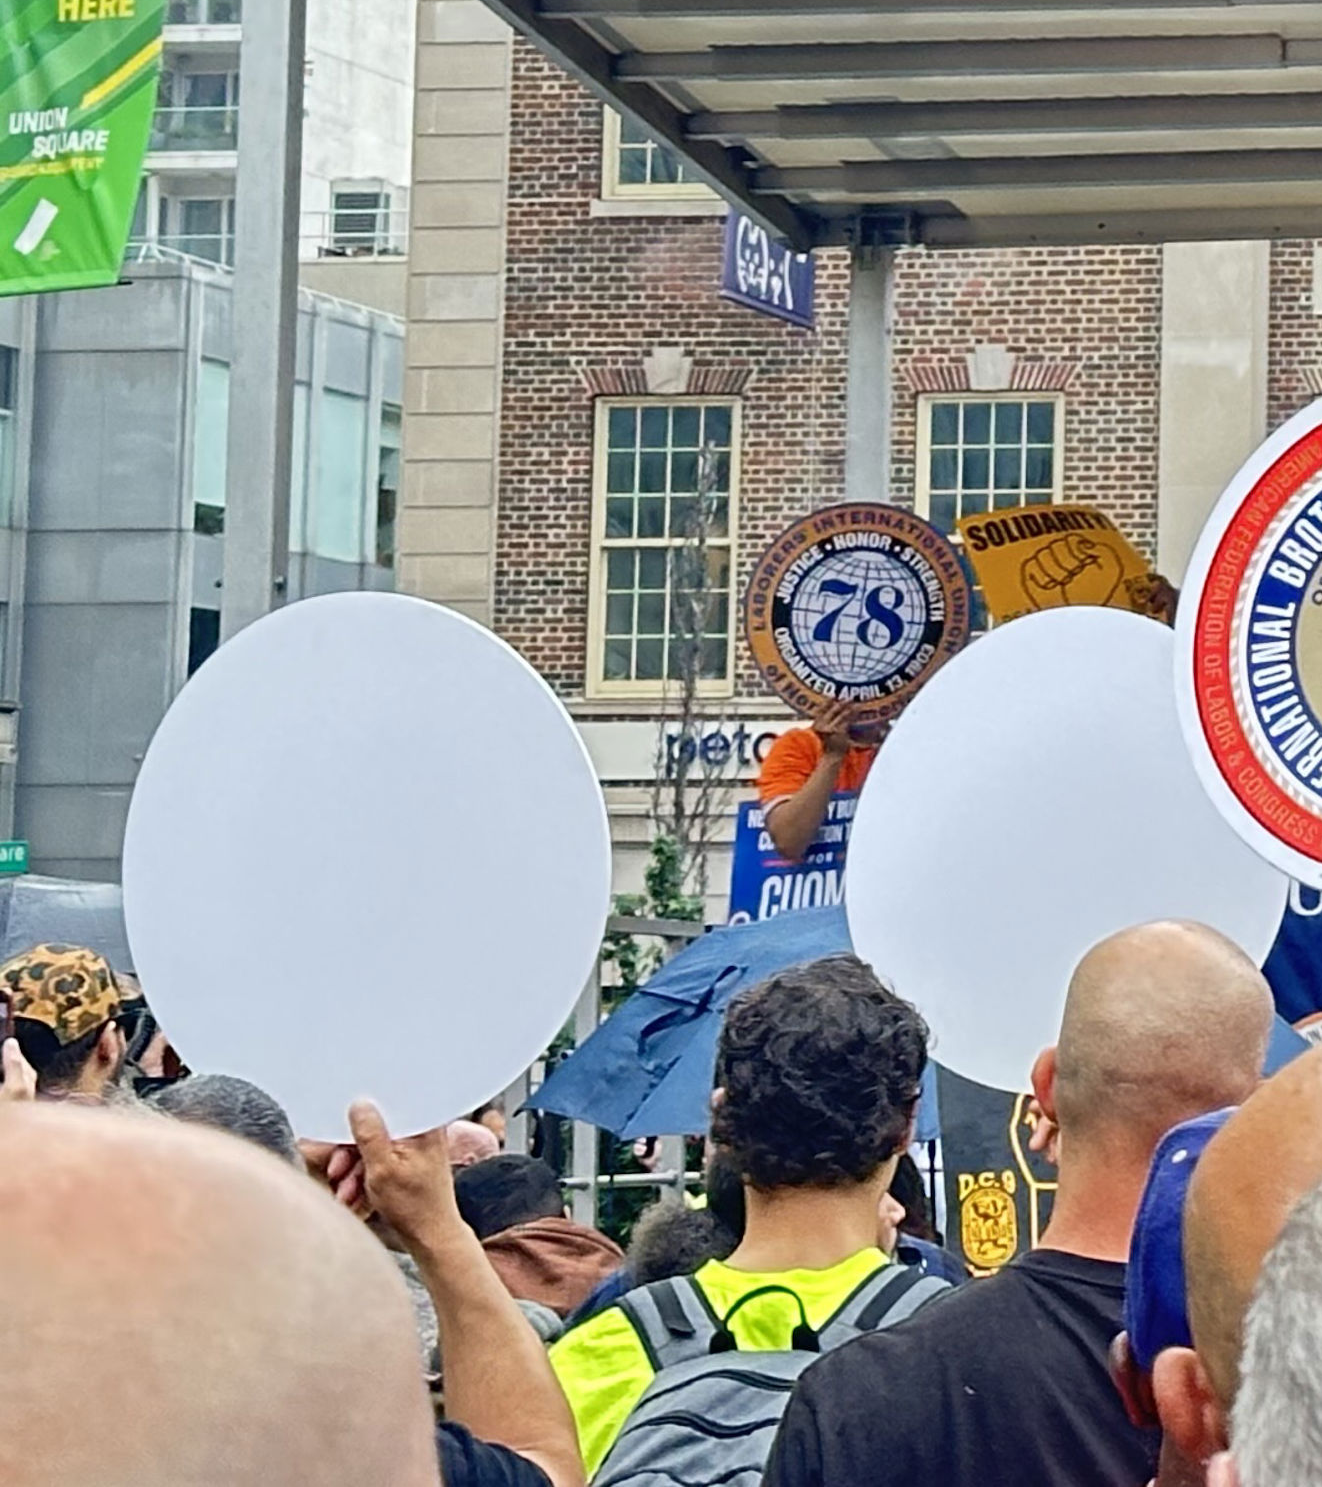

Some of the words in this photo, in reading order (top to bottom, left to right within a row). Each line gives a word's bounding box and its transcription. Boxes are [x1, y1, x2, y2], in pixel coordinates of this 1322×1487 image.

[9, 106, 69, 134] UNION
[32, 129, 110, 160] SQUARE
[813, 512, 958, 583] INTERNATIONAL
[776, 545, 826, 605] JUSTICE
[833, 532, 892, 551] HONOR
[900, 547, 945, 622] STRENGTH
[1204, 528, 1254, 648] FEDERATION
[813, 579, 904, 650] 78
[774, 627, 836, 697] ORGANIZED
[838, 684, 885, 701] APRIL
[1203, 656, 1223, 679] OF
[1204, 686, 1238, 750] LABOR
[1227, 750, 1246, 769] &
[747, 809, 765, 828] NE
[1238, 769, 1319, 844] CONGRESS
[0, 846, 25, 861] are
[759, 870, 845, 921] CUOM
